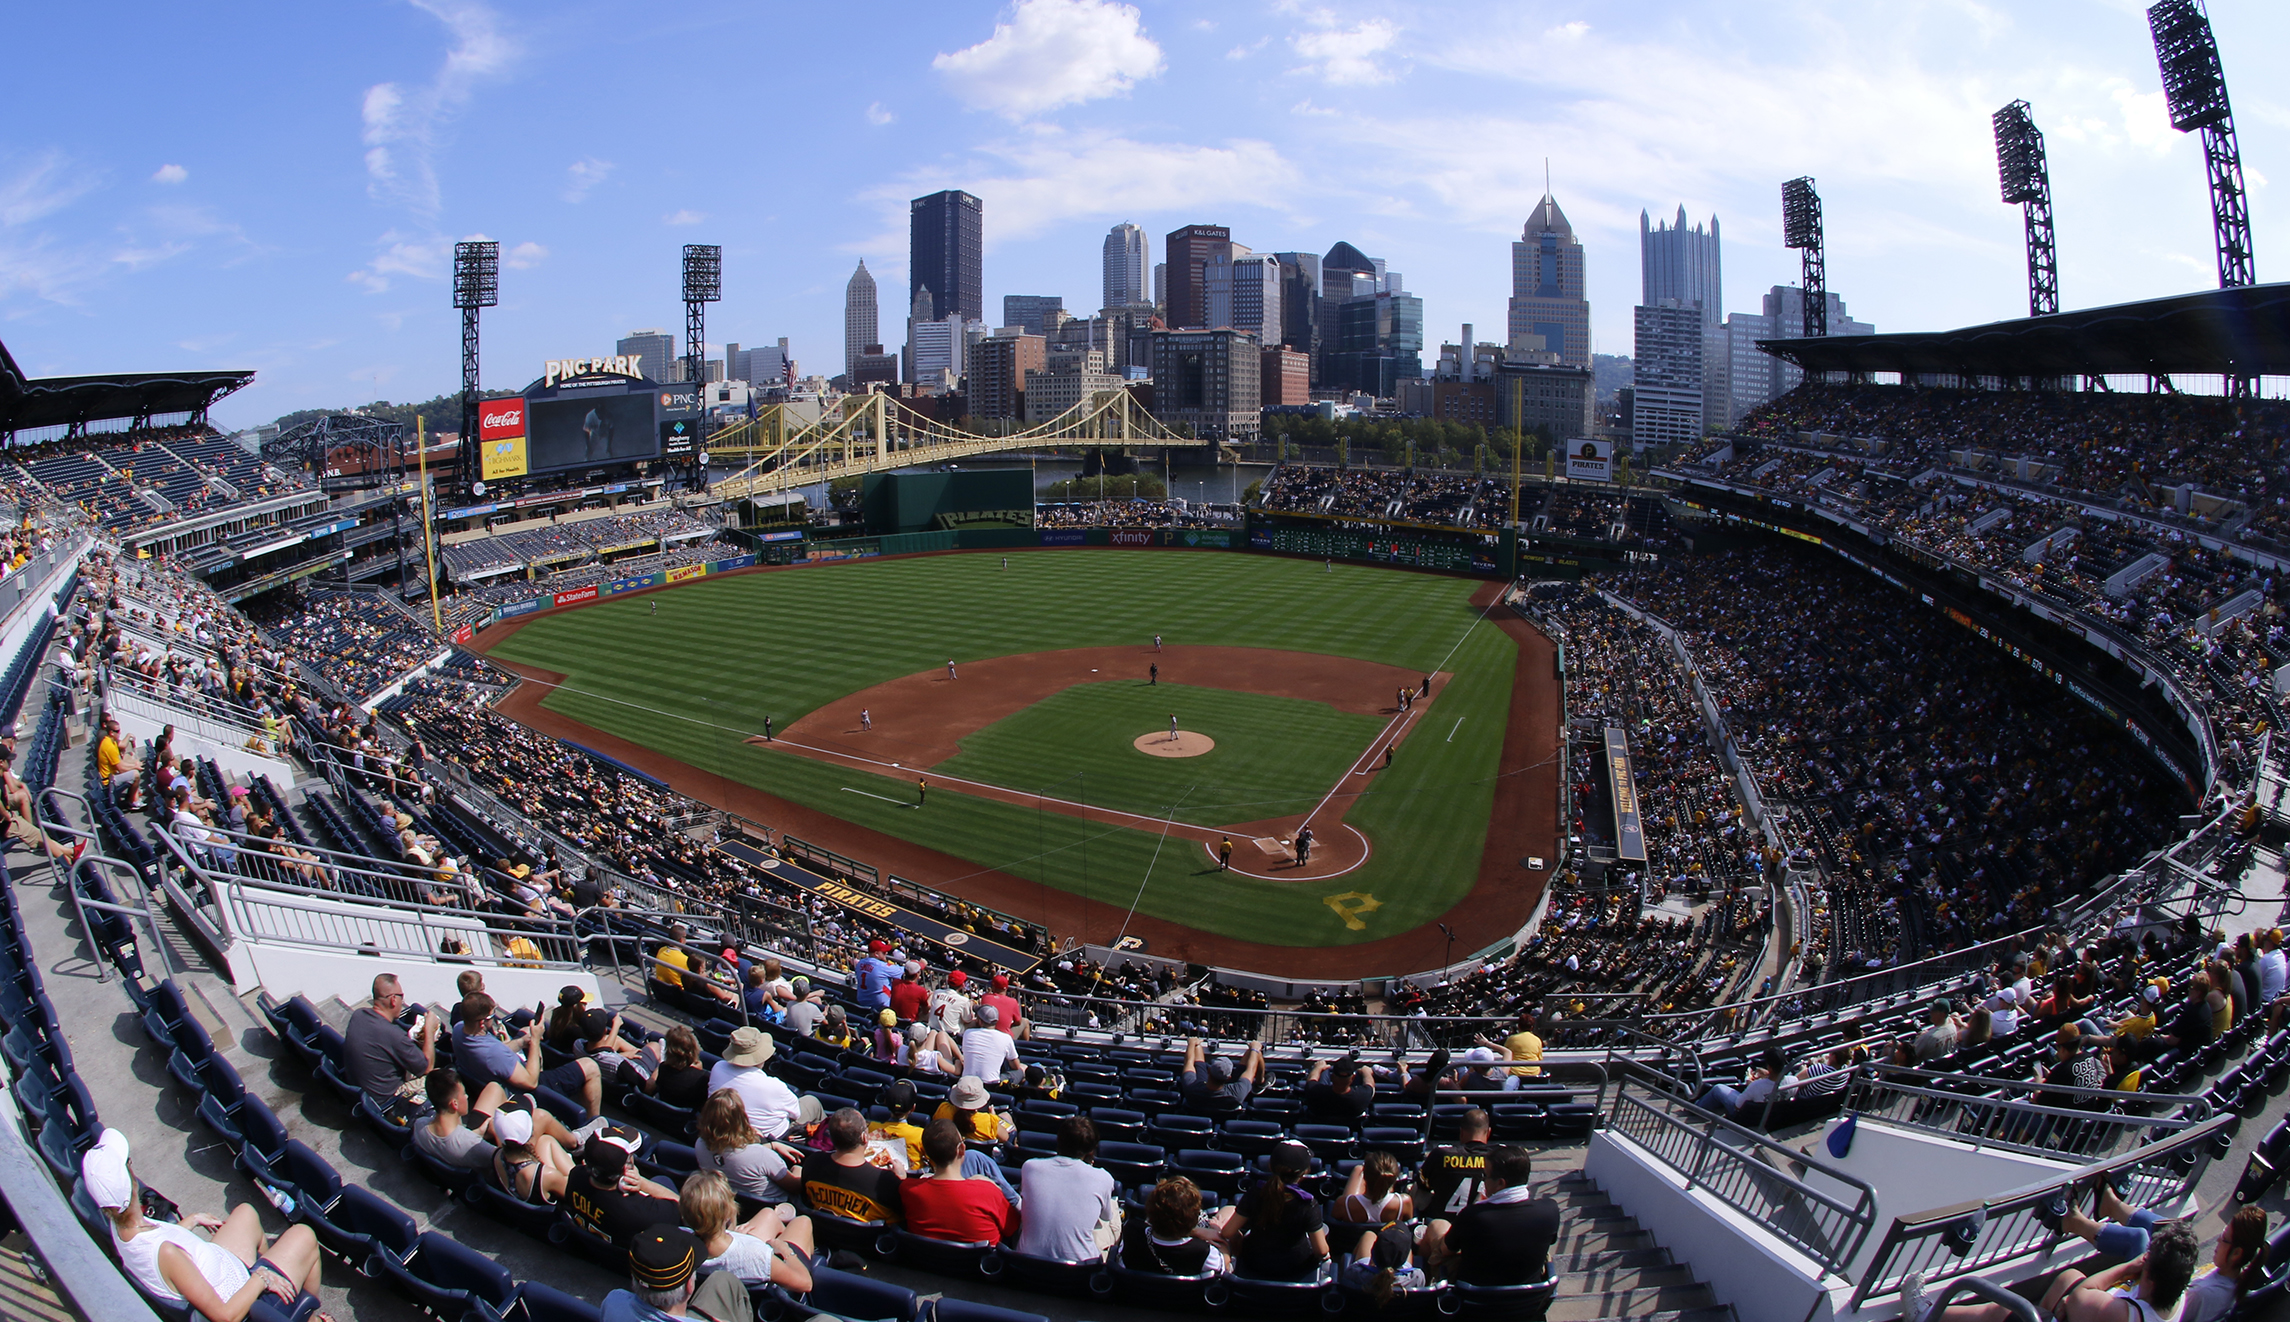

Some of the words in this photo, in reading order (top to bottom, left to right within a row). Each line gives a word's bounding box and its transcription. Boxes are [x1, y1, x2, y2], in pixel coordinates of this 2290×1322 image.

[545, 358, 588, 388] PNC
[590, 354, 643, 380] PARK
[672, 393, 695, 404] PNC
[483, 410, 522, 428] Coca-Cola
[488, 454, 522, 465] HIGHMARK
[1572, 461, 1604, 470] PIRATES
[942, 509, 1033, 528] PIRATES
[1112, 531, 1151, 545] xfinity
[1164, 533, 1174, 545] P
[2012, 646, 2021, 658] 26
[2055, 672, 2062, 684] 19
[1614, 757, 1626, 770] PARK
[1615, 769, 1628, 780] PNC
[1618, 786, 1634, 813] WELCOME
[814, 881, 898, 918] PIRATES
[1322, 890, 1384, 931] P
[860, 972, 867, 990] 1
[936, 993, 957, 1006] MOLINA
[934, 1004, 946, 1021] 4
[572, 1191, 604, 1225] COLE
